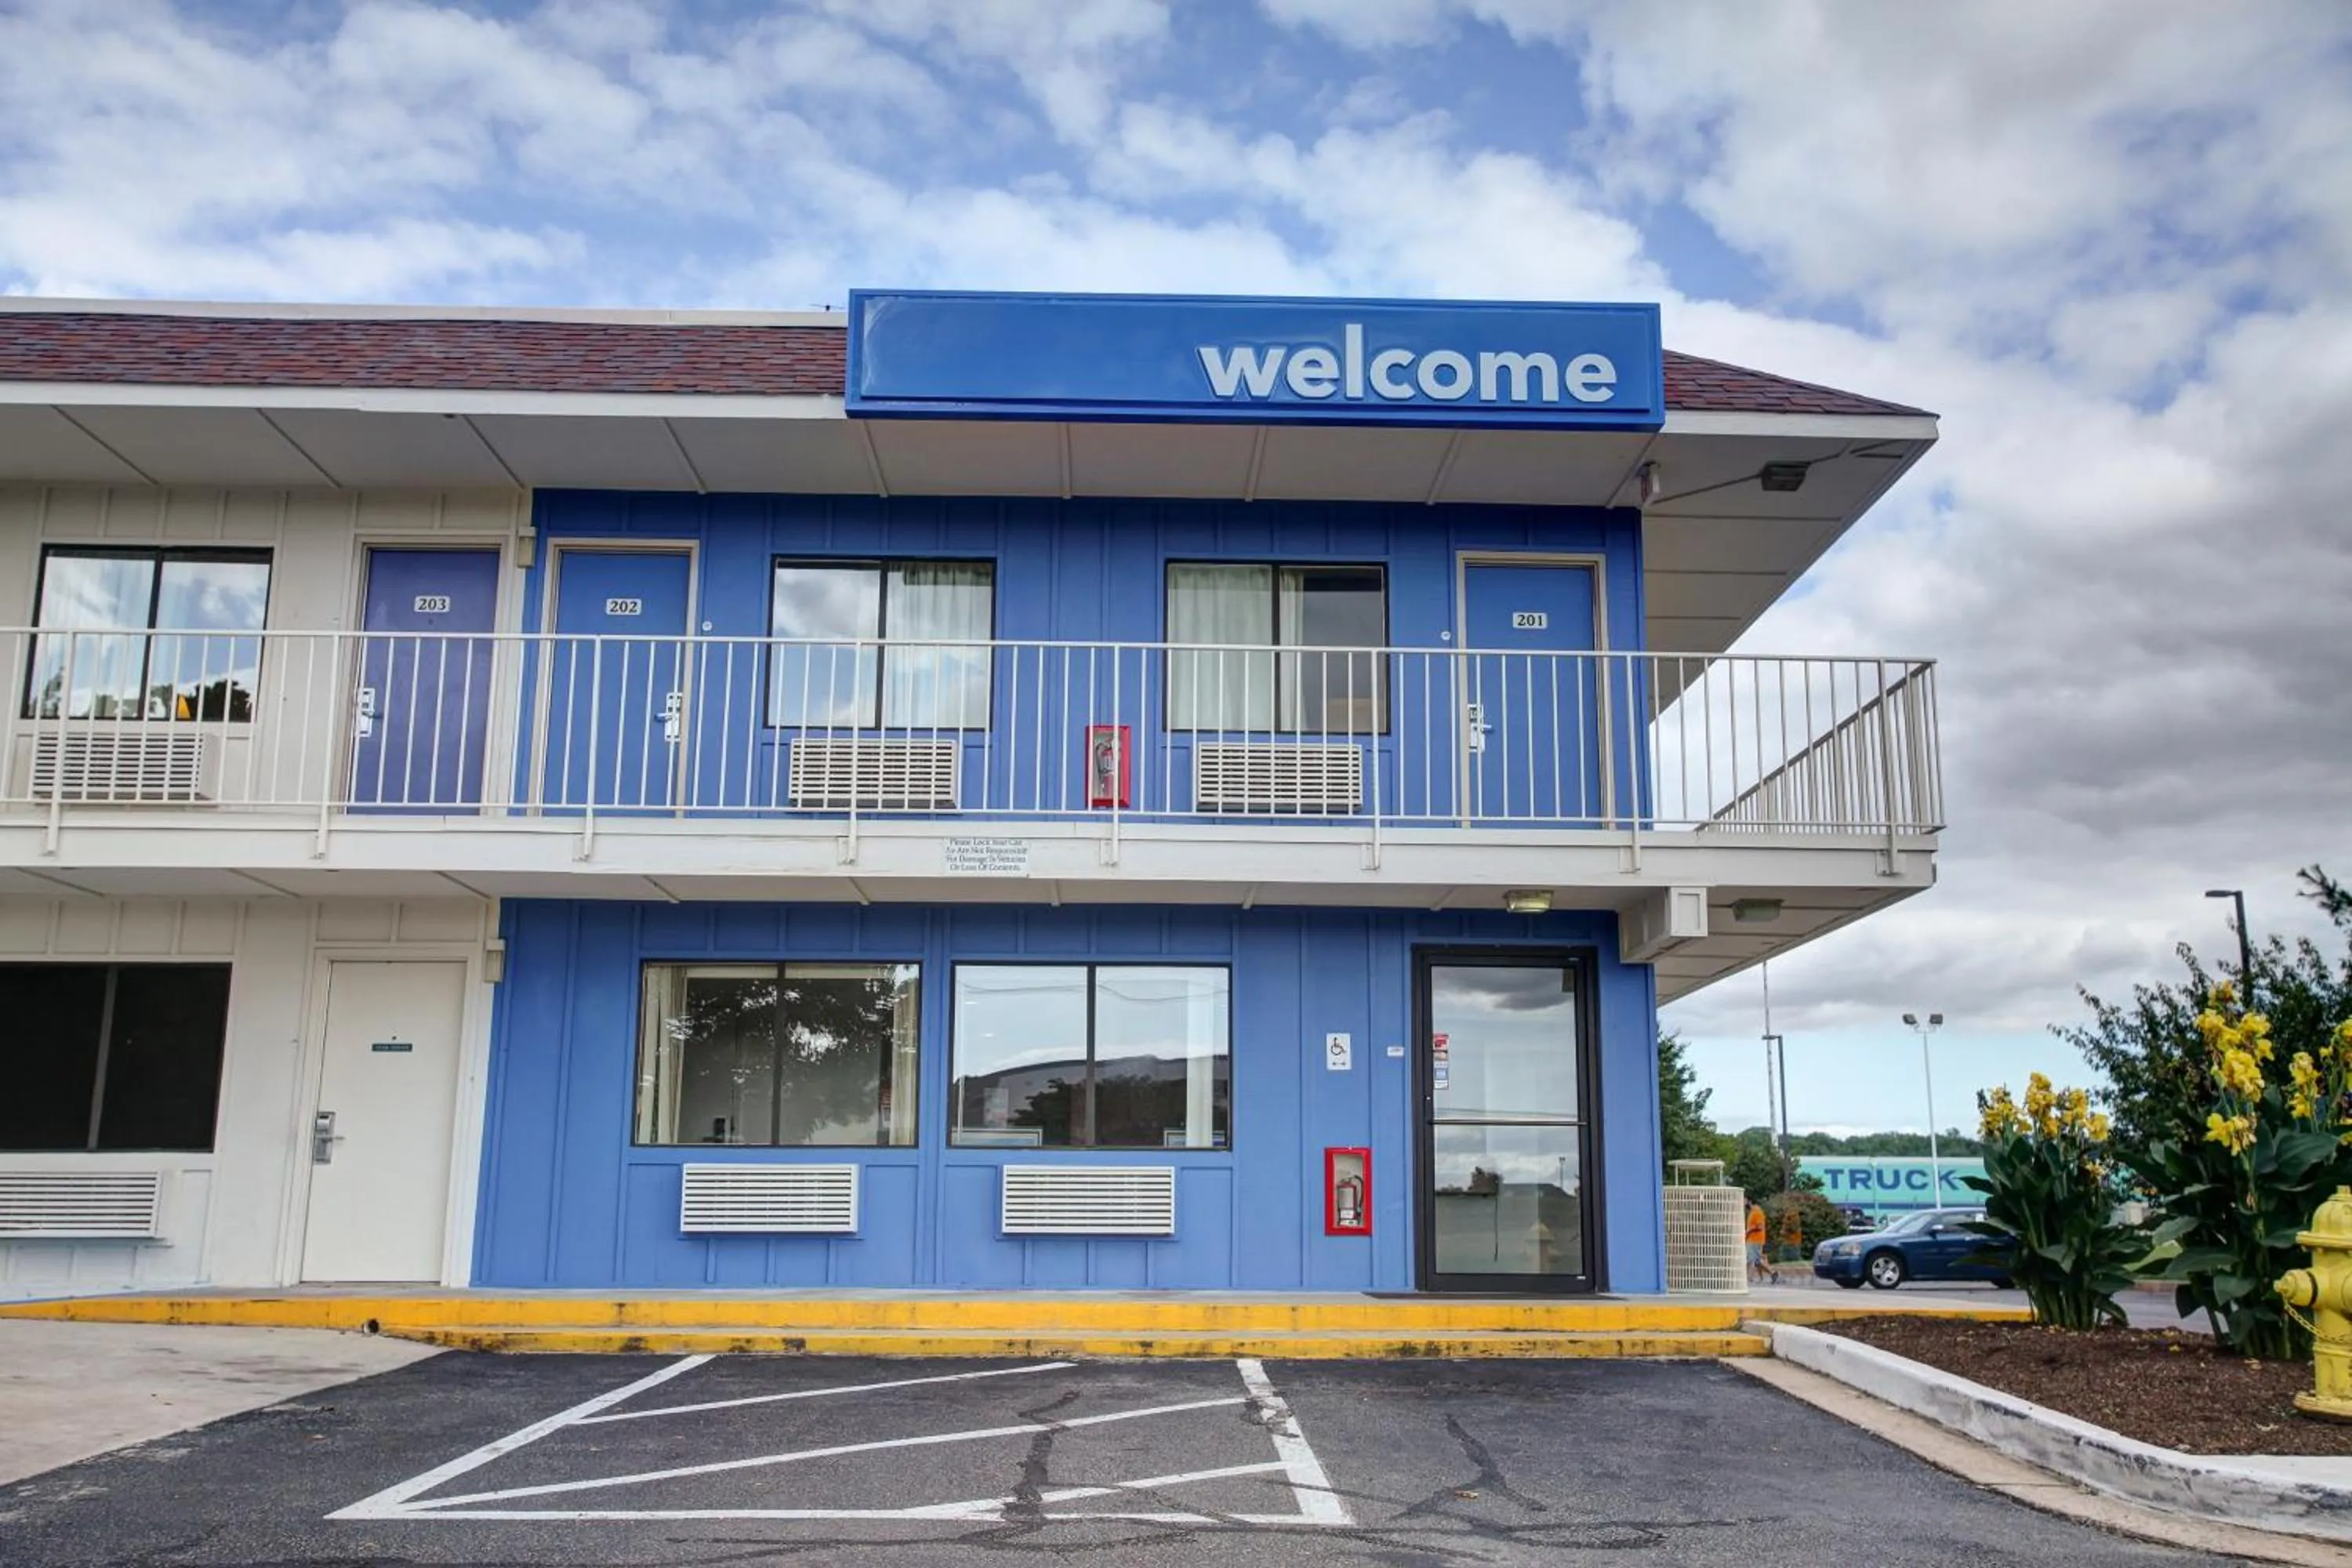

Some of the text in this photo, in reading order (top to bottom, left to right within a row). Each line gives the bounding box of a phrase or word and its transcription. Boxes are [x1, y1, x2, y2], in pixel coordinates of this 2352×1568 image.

[1196, 323, 1617, 402] welcome
[418, 598, 446, 611] 203
[610, 601, 637, 613] 202
[1517, 614, 1543, 626] 201
[1824, 1168, 1960, 1191] TRUCK
